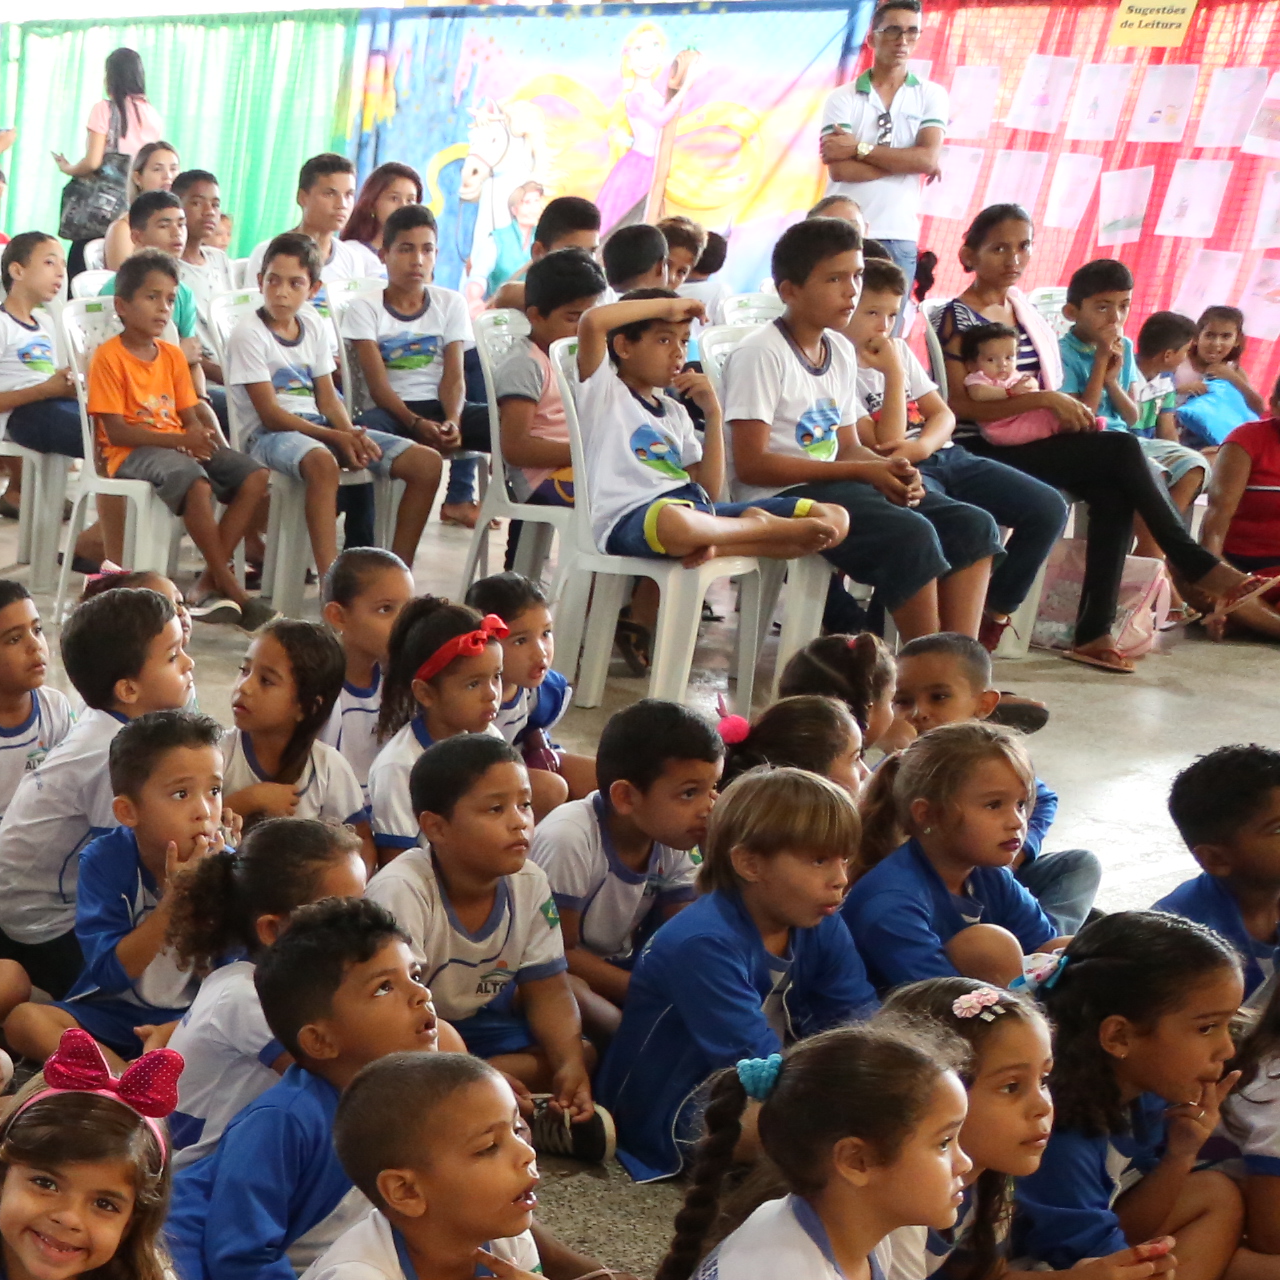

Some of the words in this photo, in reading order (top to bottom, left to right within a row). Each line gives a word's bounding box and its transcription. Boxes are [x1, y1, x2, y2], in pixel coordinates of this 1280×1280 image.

[1126, 5, 1187, 16] Sugestões
[1120, 20, 1134, 29] de
[1137, 20, 1182, 29] Leitura
